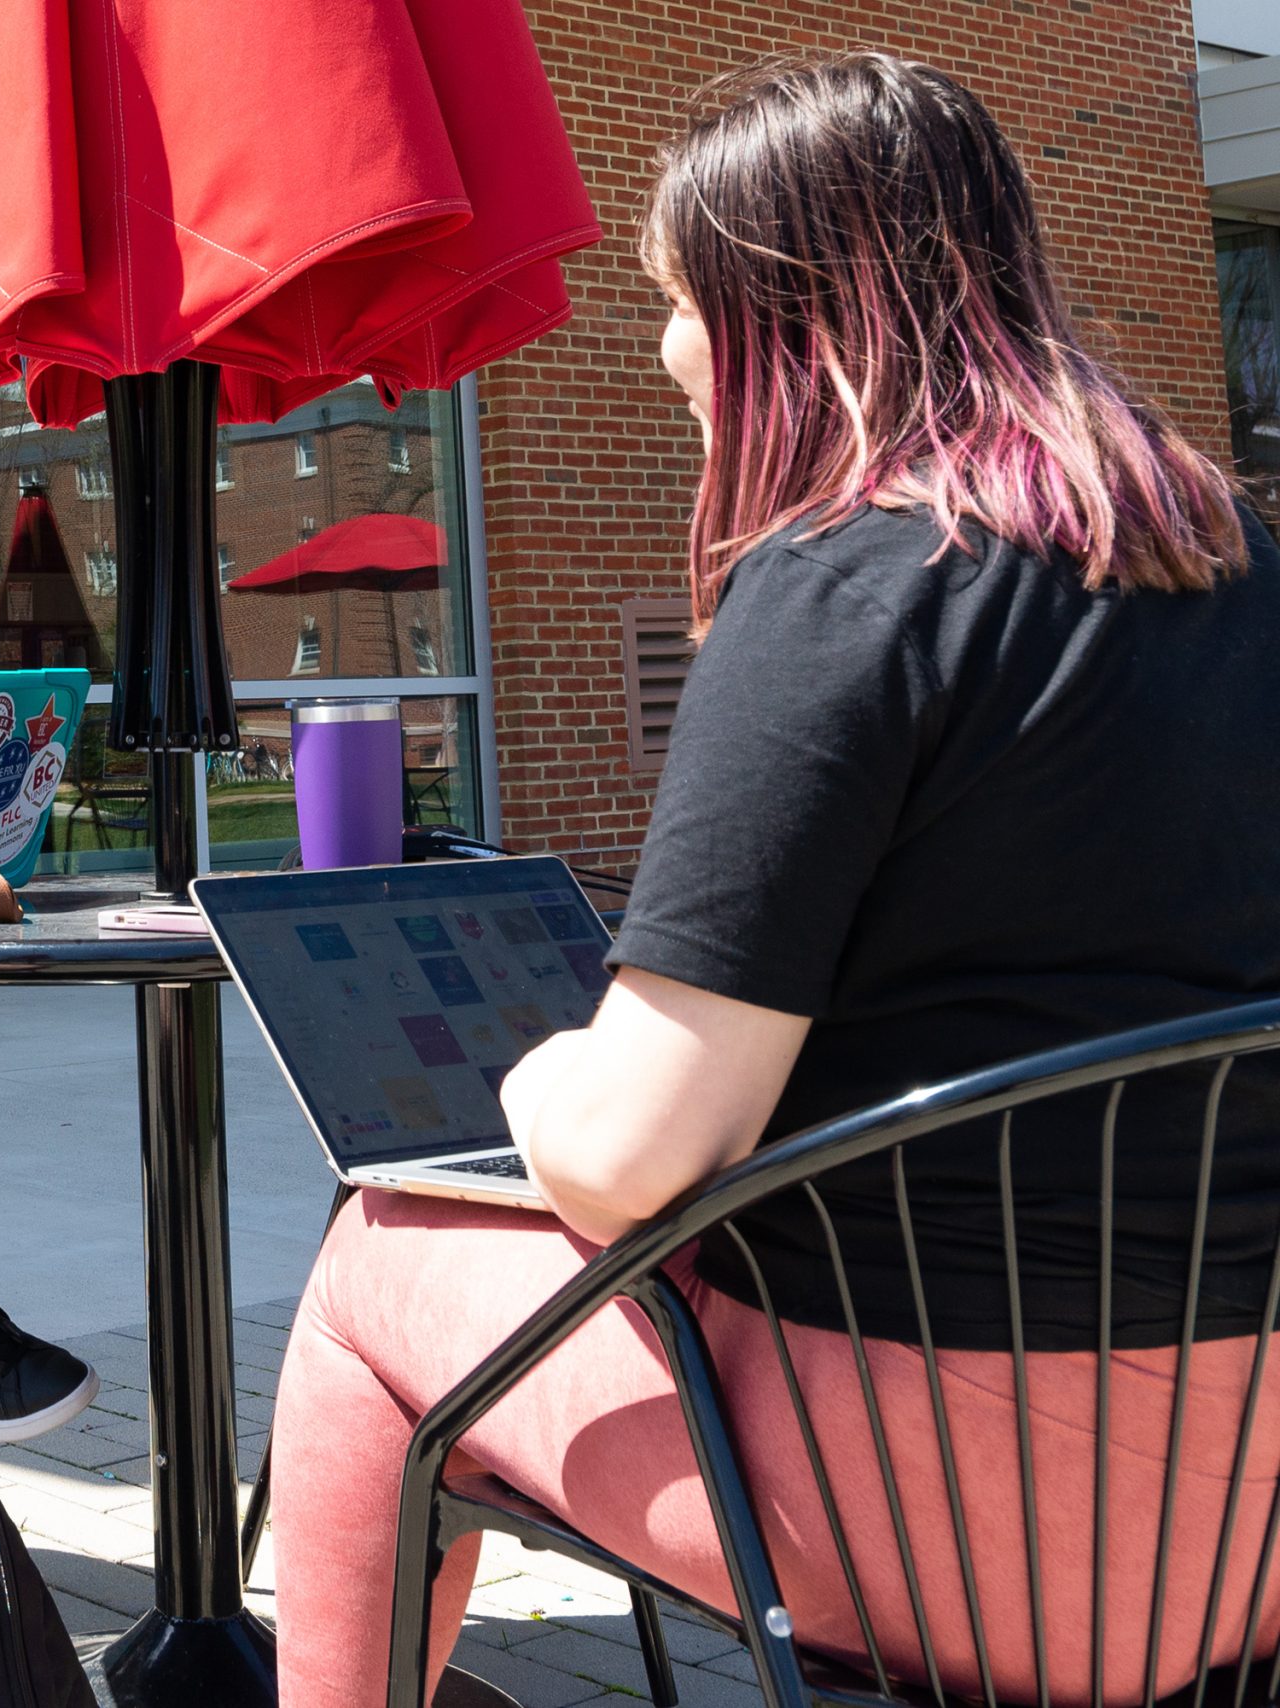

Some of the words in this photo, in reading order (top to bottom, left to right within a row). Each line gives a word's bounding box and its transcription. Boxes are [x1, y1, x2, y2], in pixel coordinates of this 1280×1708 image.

[33, 757, 56, 791] BC
[30, 780, 56, 801] UNITED
[1, 806, 22, 828] FLC
[5, 817, 34, 837] Learning
